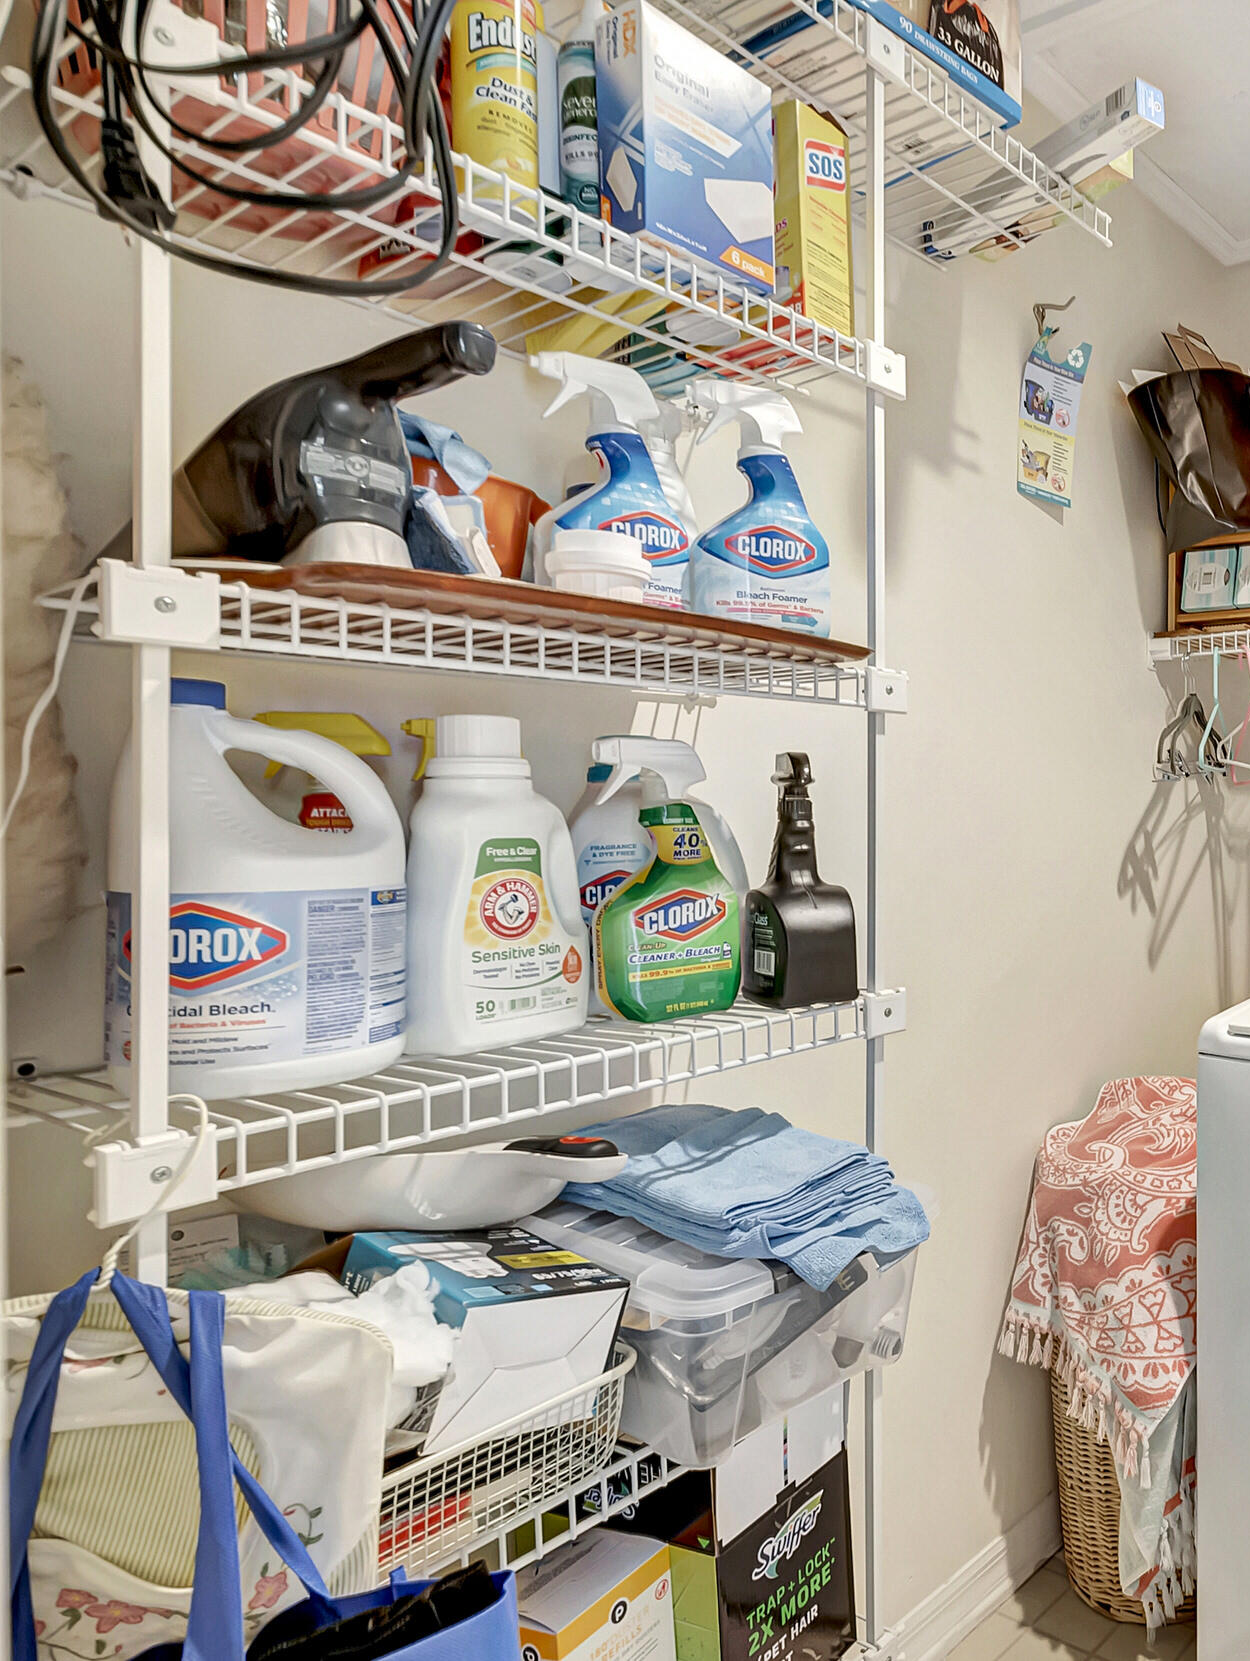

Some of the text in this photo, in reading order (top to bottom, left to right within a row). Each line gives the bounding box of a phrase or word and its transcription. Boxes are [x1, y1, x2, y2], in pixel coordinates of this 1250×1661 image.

[622, 9, 637, 58] HDX
[899, 16, 914, 34] 90
[467, 11, 536, 65] Endust
[938, 27, 1000, 83] 33 GALLON
[654, 54, 711, 98] Original
[475, 85, 518, 107] Clean
[491, 77, 525, 101] Dust
[732, 249, 767, 278] 6 pack
[737, 535, 806, 561] CLOROX
[647, 582, 682, 595] Foamer
[736, 591, 807, 603] Bleach Foamer
[311, 808, 345, 817] ATTAC
[486, 847, 509, 856] Free
[590, 843, 637, 851] FRAGRANCE
[673, 849, 701, 857] MORE
[484, 894, 498, 917] ARM
[506, 881, 537, 913] HAMMER
[643, 893, 720, 935] CLOROX
[472, 942, 560, 963] Sensitive Skin
[629, 952, 676, 964] CLEANER
[685, 946, 720, 957] BLEACH
[476, 1000, 496, 1014] 50
[752, 1503, 822, 1580] Swiffer
[746, 1585, 785, 1630] TRAP
[798, 1542, 831, 1585] LOCK
[748, 1560, 832, 1657] 2X MORE
[790, 1603, 819, 1640] HAIR
